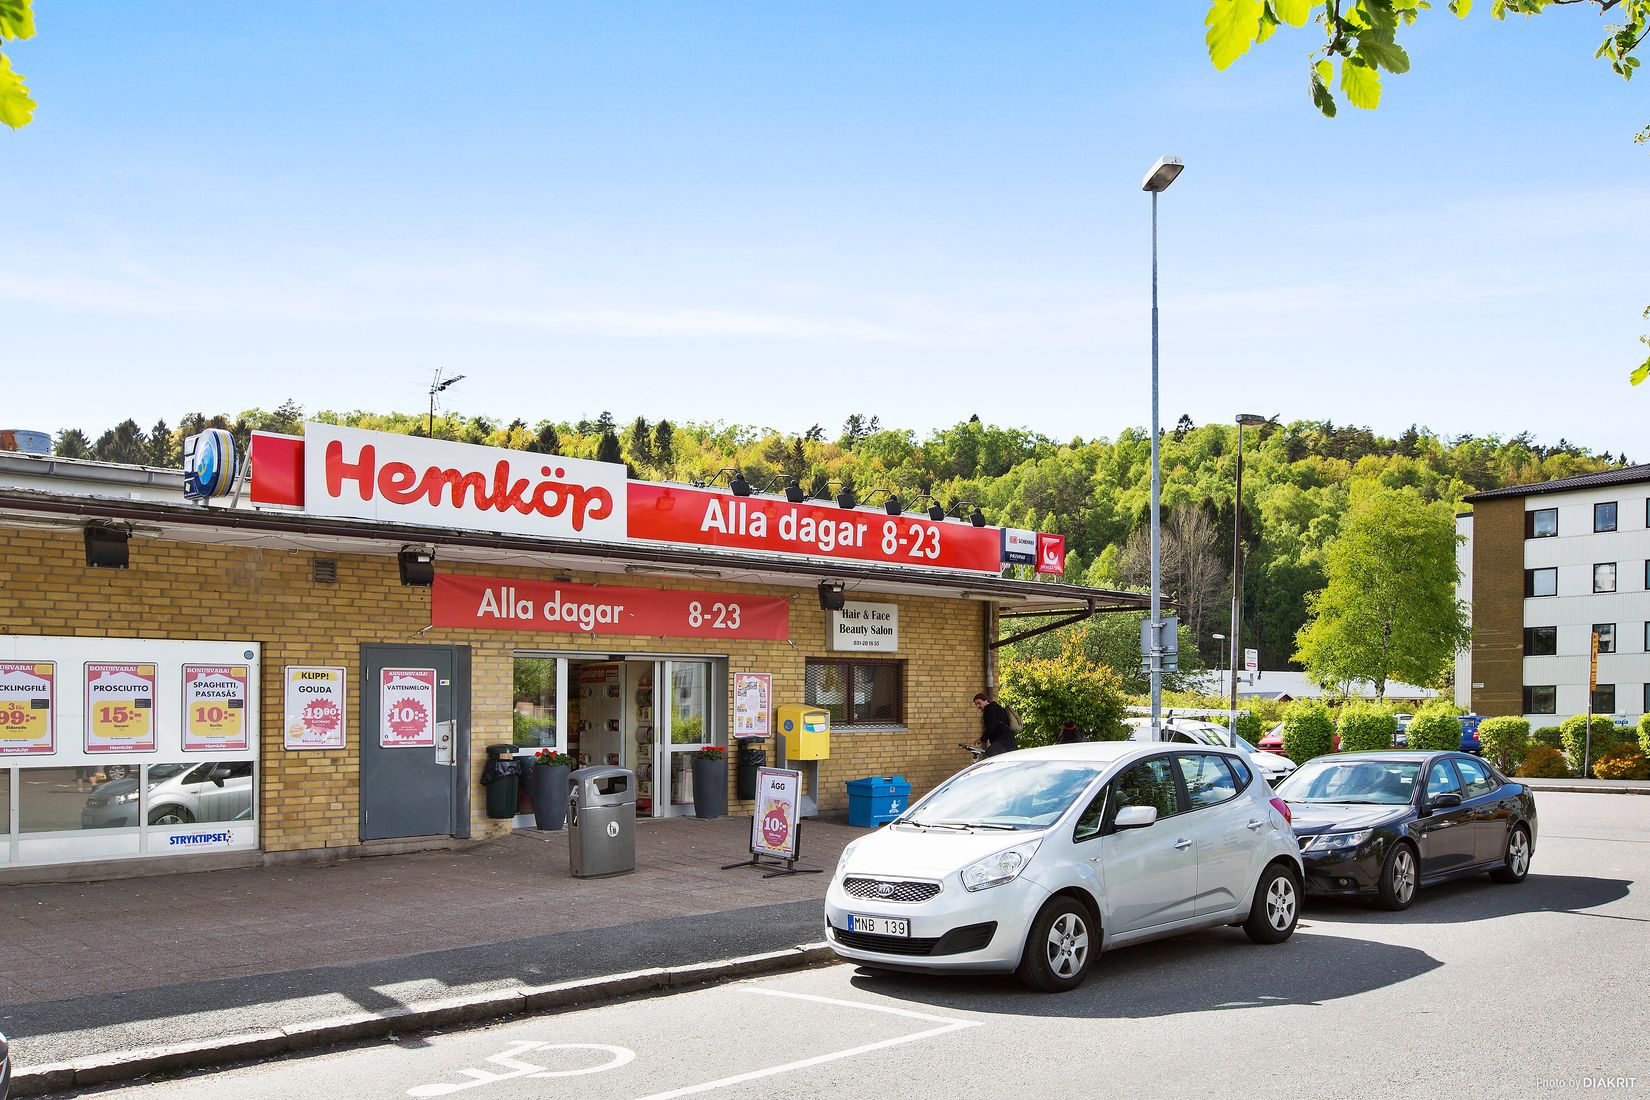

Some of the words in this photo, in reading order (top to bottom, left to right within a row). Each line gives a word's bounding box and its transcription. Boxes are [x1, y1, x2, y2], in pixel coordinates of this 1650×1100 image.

[324, 439, 614, 533] Hemköp
[700, 498, 767, 538] Alla
[778, 508, 868, 552] dagar
[881, 520, 941, 560] 8-23
[476, 586, 535, 620] Alla
[543, 590, 624, 632] dagar
[687, 600, 742, 630] 8-23
[842, 608, 861, 619] Hair
[863, 610, 870, 620] &
[871, 610, 891, 621] Face
[839, 623, 869, 637] Beauty
[870, 624, 893, 636] Salon
[301, 671, 330, 680] KLIPP!
[93, 684, 149, 692] PROSCIUTTO
[193, 681, 239, 690] SPAGHETTI,
[298, 685, 333, 694] GOUDA
[195, 689, 237, 698] PASTASÅS
[8, 702, 15, 711] 3
[100, 706, 142, 724] 15:-
[195, 706, 236, 723] 10:-
[391, 707, 425, 723] 10:-
[770, 780, 786, 791] ÄGG
[764, 816, 787, 832] 10:-
[169, 832, 227, 846] STRYKTIPSET
[854, 917, 875, 932] MNB
[884, 920, 906, 935] 139
